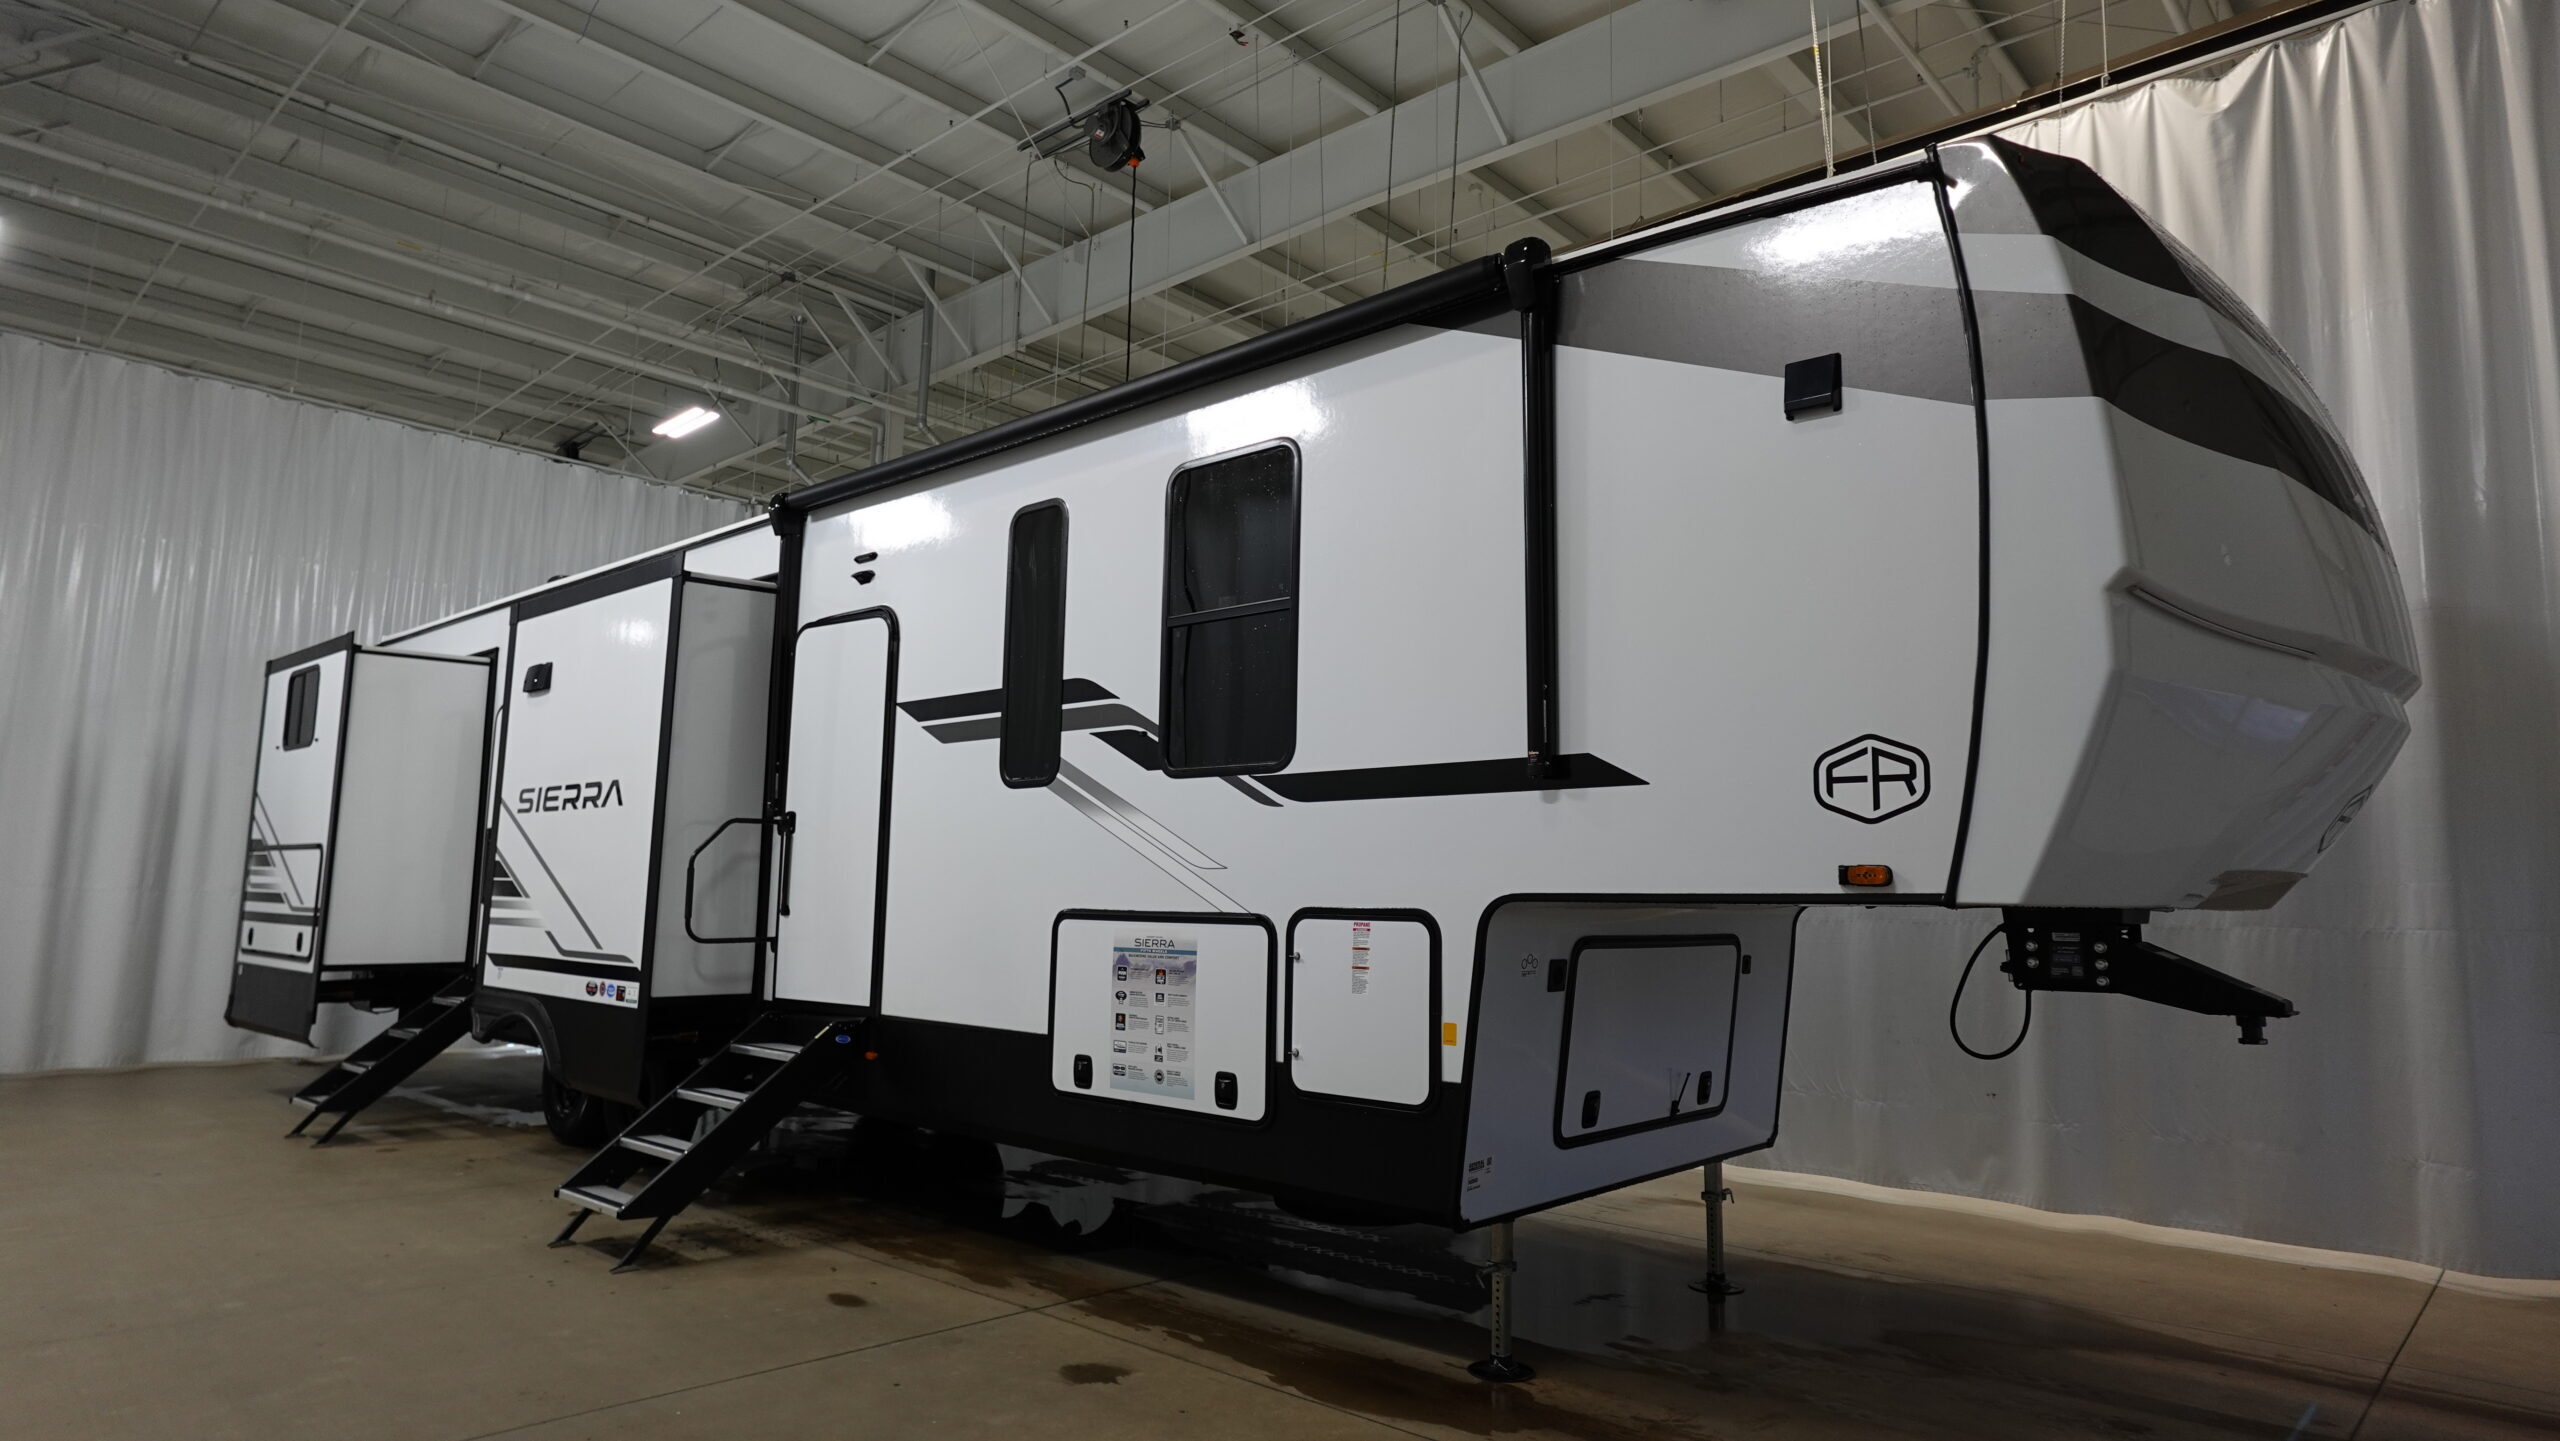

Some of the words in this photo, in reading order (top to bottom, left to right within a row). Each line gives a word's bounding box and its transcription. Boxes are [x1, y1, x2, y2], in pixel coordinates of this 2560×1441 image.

[1826, 746, 1917, 811] FR
[517, 779, 623, 814] SIERRA
[1134, 938, 1175, 948] SIERRA
